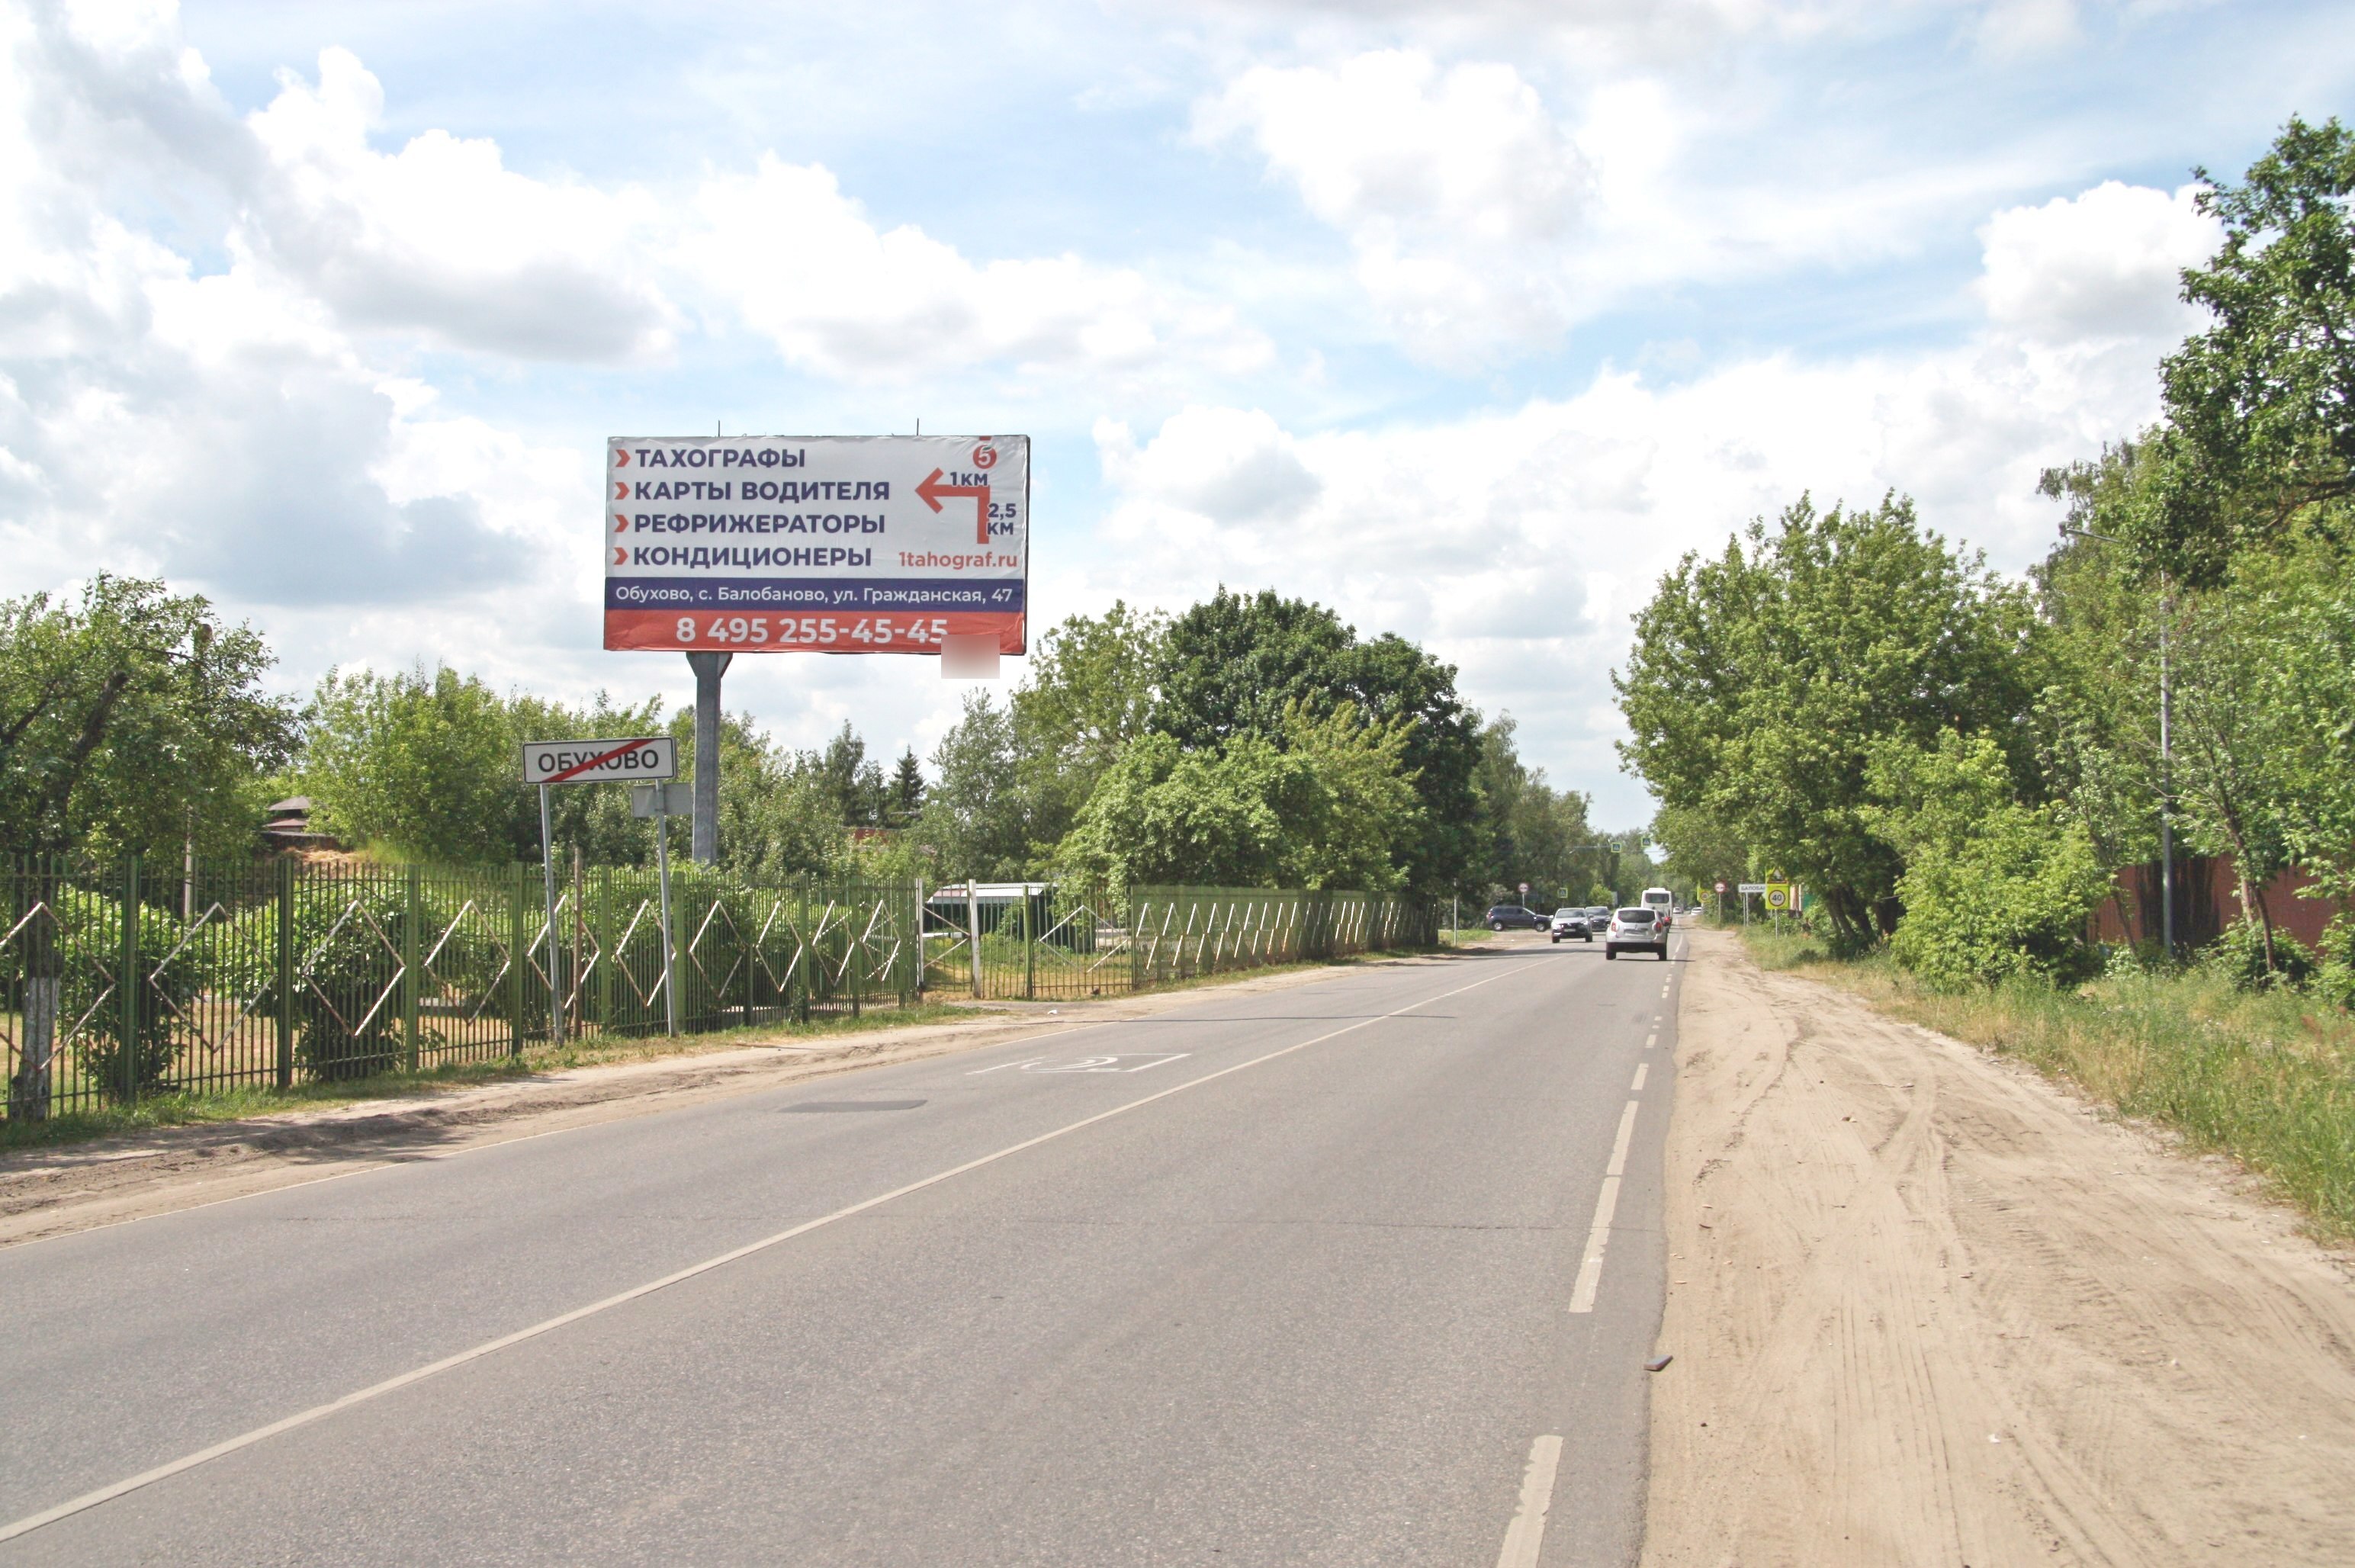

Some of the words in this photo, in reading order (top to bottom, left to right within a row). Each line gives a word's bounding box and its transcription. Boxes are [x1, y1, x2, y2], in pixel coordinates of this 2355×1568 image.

[635, 448, 805, 468] ТАХОГРАФЫ
[635, 481, 731, 500] КАРТЫ
[741, 481, 890, 503] ВОДИТЕЛЯ
[988, 503, 1017, 520] 2,5
[635, 513, 885, 533] РЕФРИЖЕРАТОРЫ
[634, 547, 872, 569] КОНДИЦИОНЕРЫ
[898, 551, 1017, 570] 1tahograf.ru
[615, 586, 693, 602] Обухово,
[699, 589, 712, 600] с.
[718, 586, 828, 602] Балобаново,
[833, 590, 858, 604] ул.
[864, 587, 986, 604] Гражданская,
[991, 589, 1013, 602] 47
[676, 617, 696, 642] 8
[708, 618, 768, 643] 495
[779, 619, 949, 644] 255-45-45
[538, 750, 659, 773] ОБУХОВО
